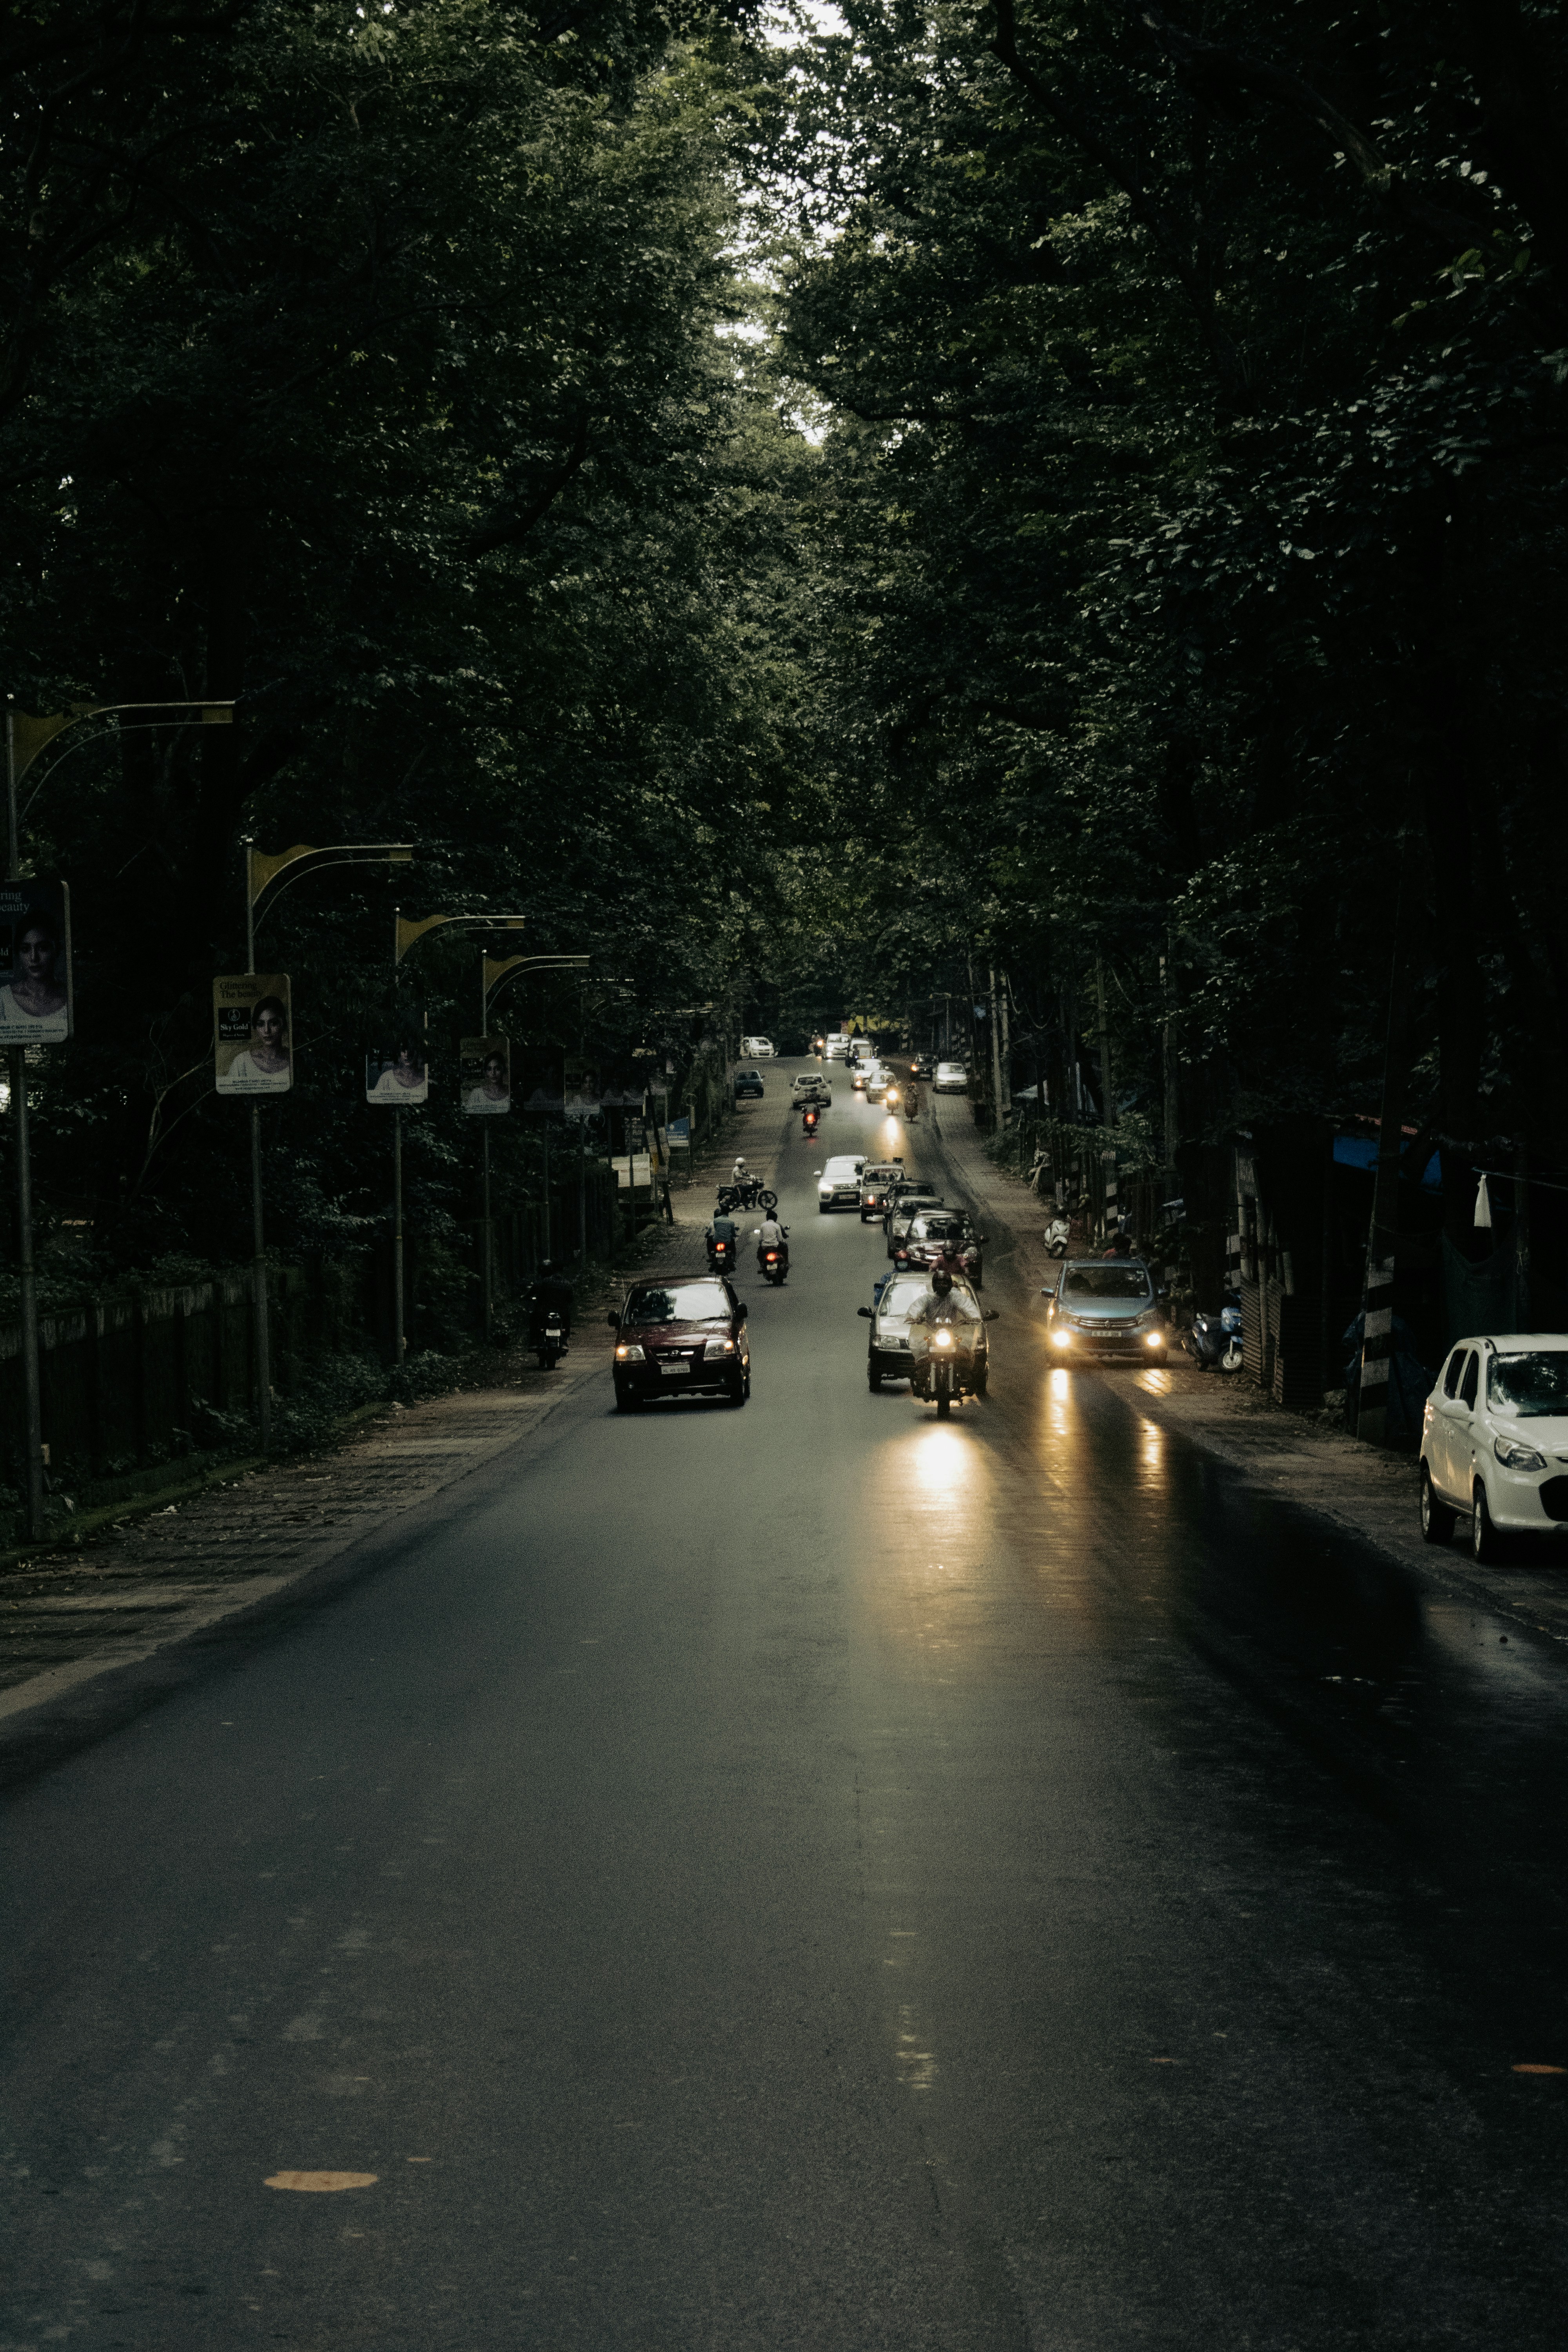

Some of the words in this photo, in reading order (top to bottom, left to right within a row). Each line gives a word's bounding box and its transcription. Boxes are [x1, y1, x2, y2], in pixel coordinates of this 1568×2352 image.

[220, 982, 257, 990] Glittering
[238, 990, 263, 999] beauty
[220, 1024, 232, 1032] Sky
